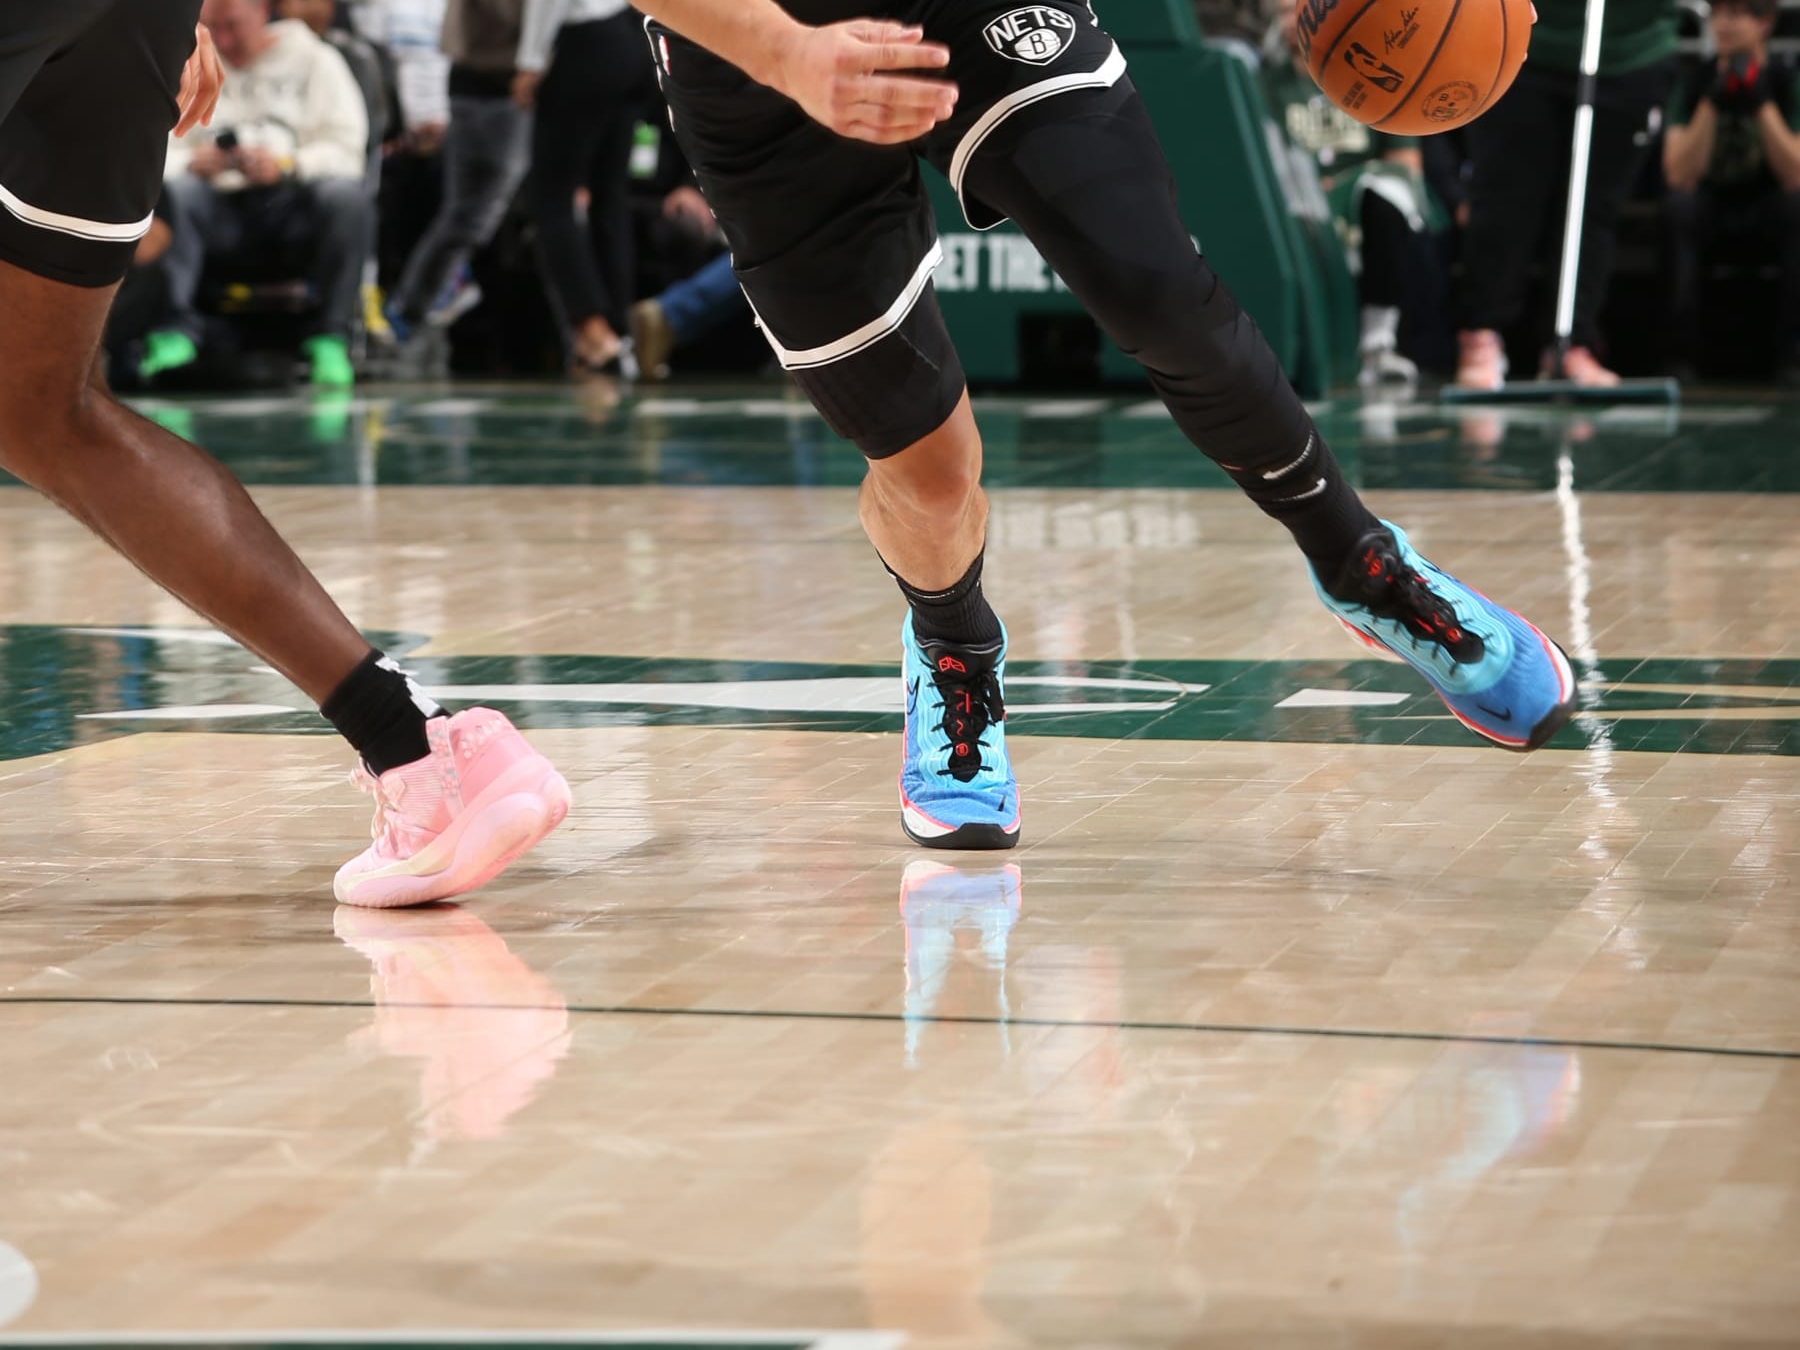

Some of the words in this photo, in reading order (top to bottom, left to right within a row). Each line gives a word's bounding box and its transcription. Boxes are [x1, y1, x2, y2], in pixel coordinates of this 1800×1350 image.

[989, 9, 1073, 50] NETS
[1029, 33, 1047, 55] B
[933, 232, 982, 291] ET
